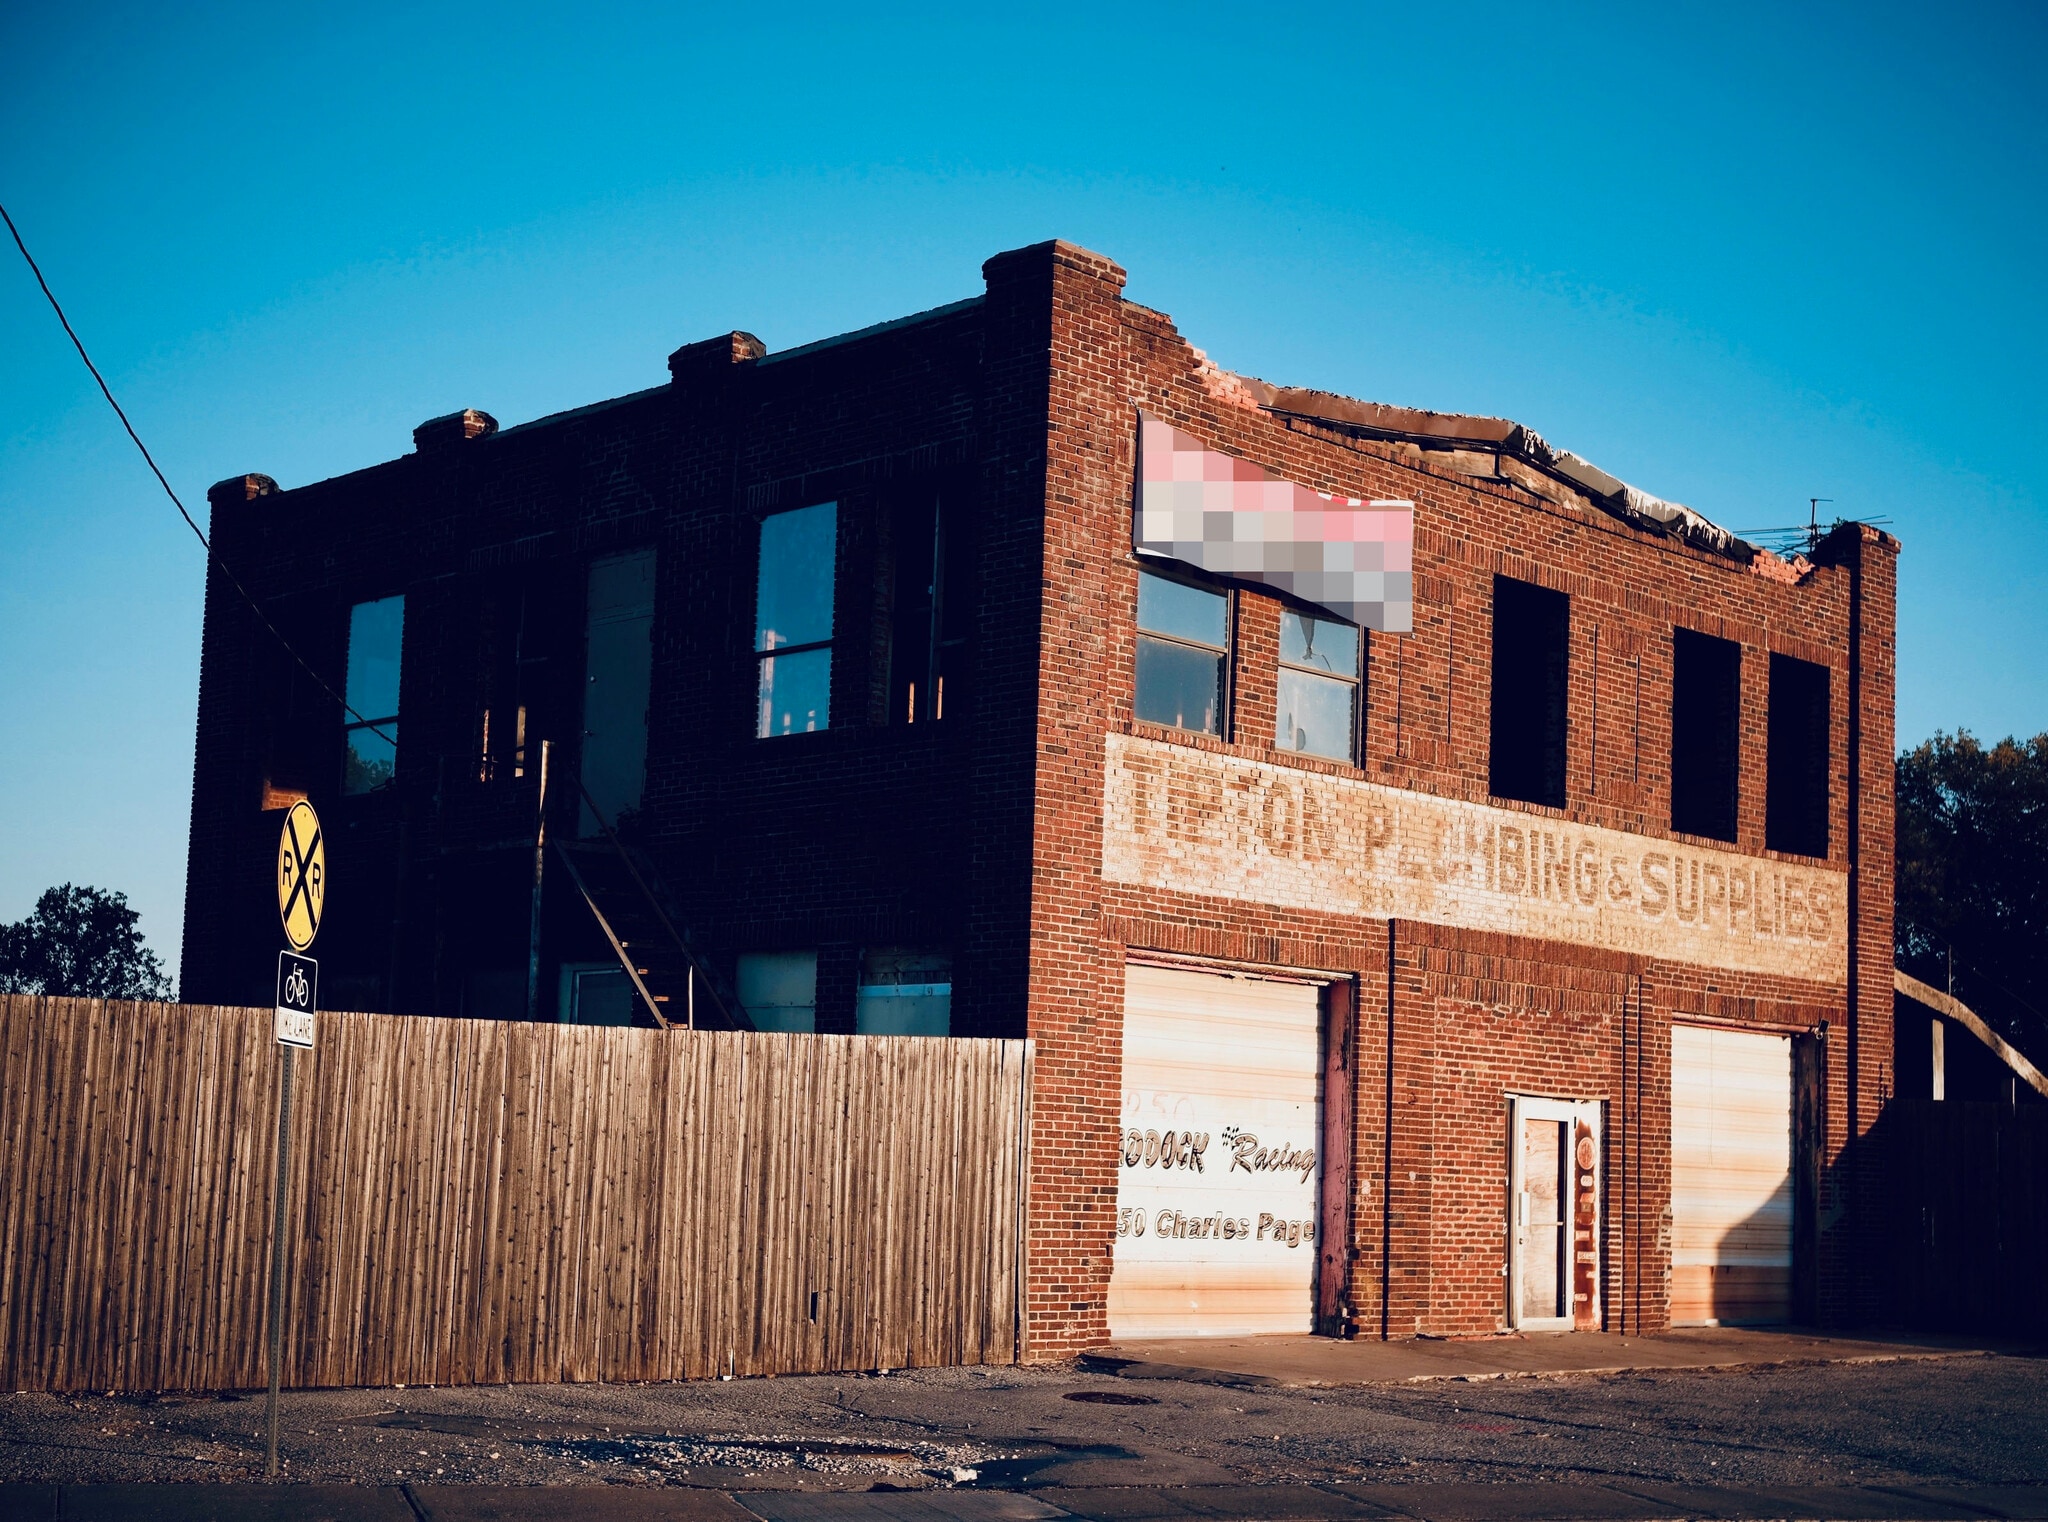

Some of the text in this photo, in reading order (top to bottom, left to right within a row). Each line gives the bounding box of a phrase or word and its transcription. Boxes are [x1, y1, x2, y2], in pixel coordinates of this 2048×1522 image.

[283, 850, 321, 900] R R
[1640, 849, 1831, 943] SUPPLIES
[280, 1012, 292, 1036] KE
[1230, 1132, 1316, 1185] Racing
[1155, 1209, 1250, 1241] Charles
[1257, 1212, 1316, 1249] Page
